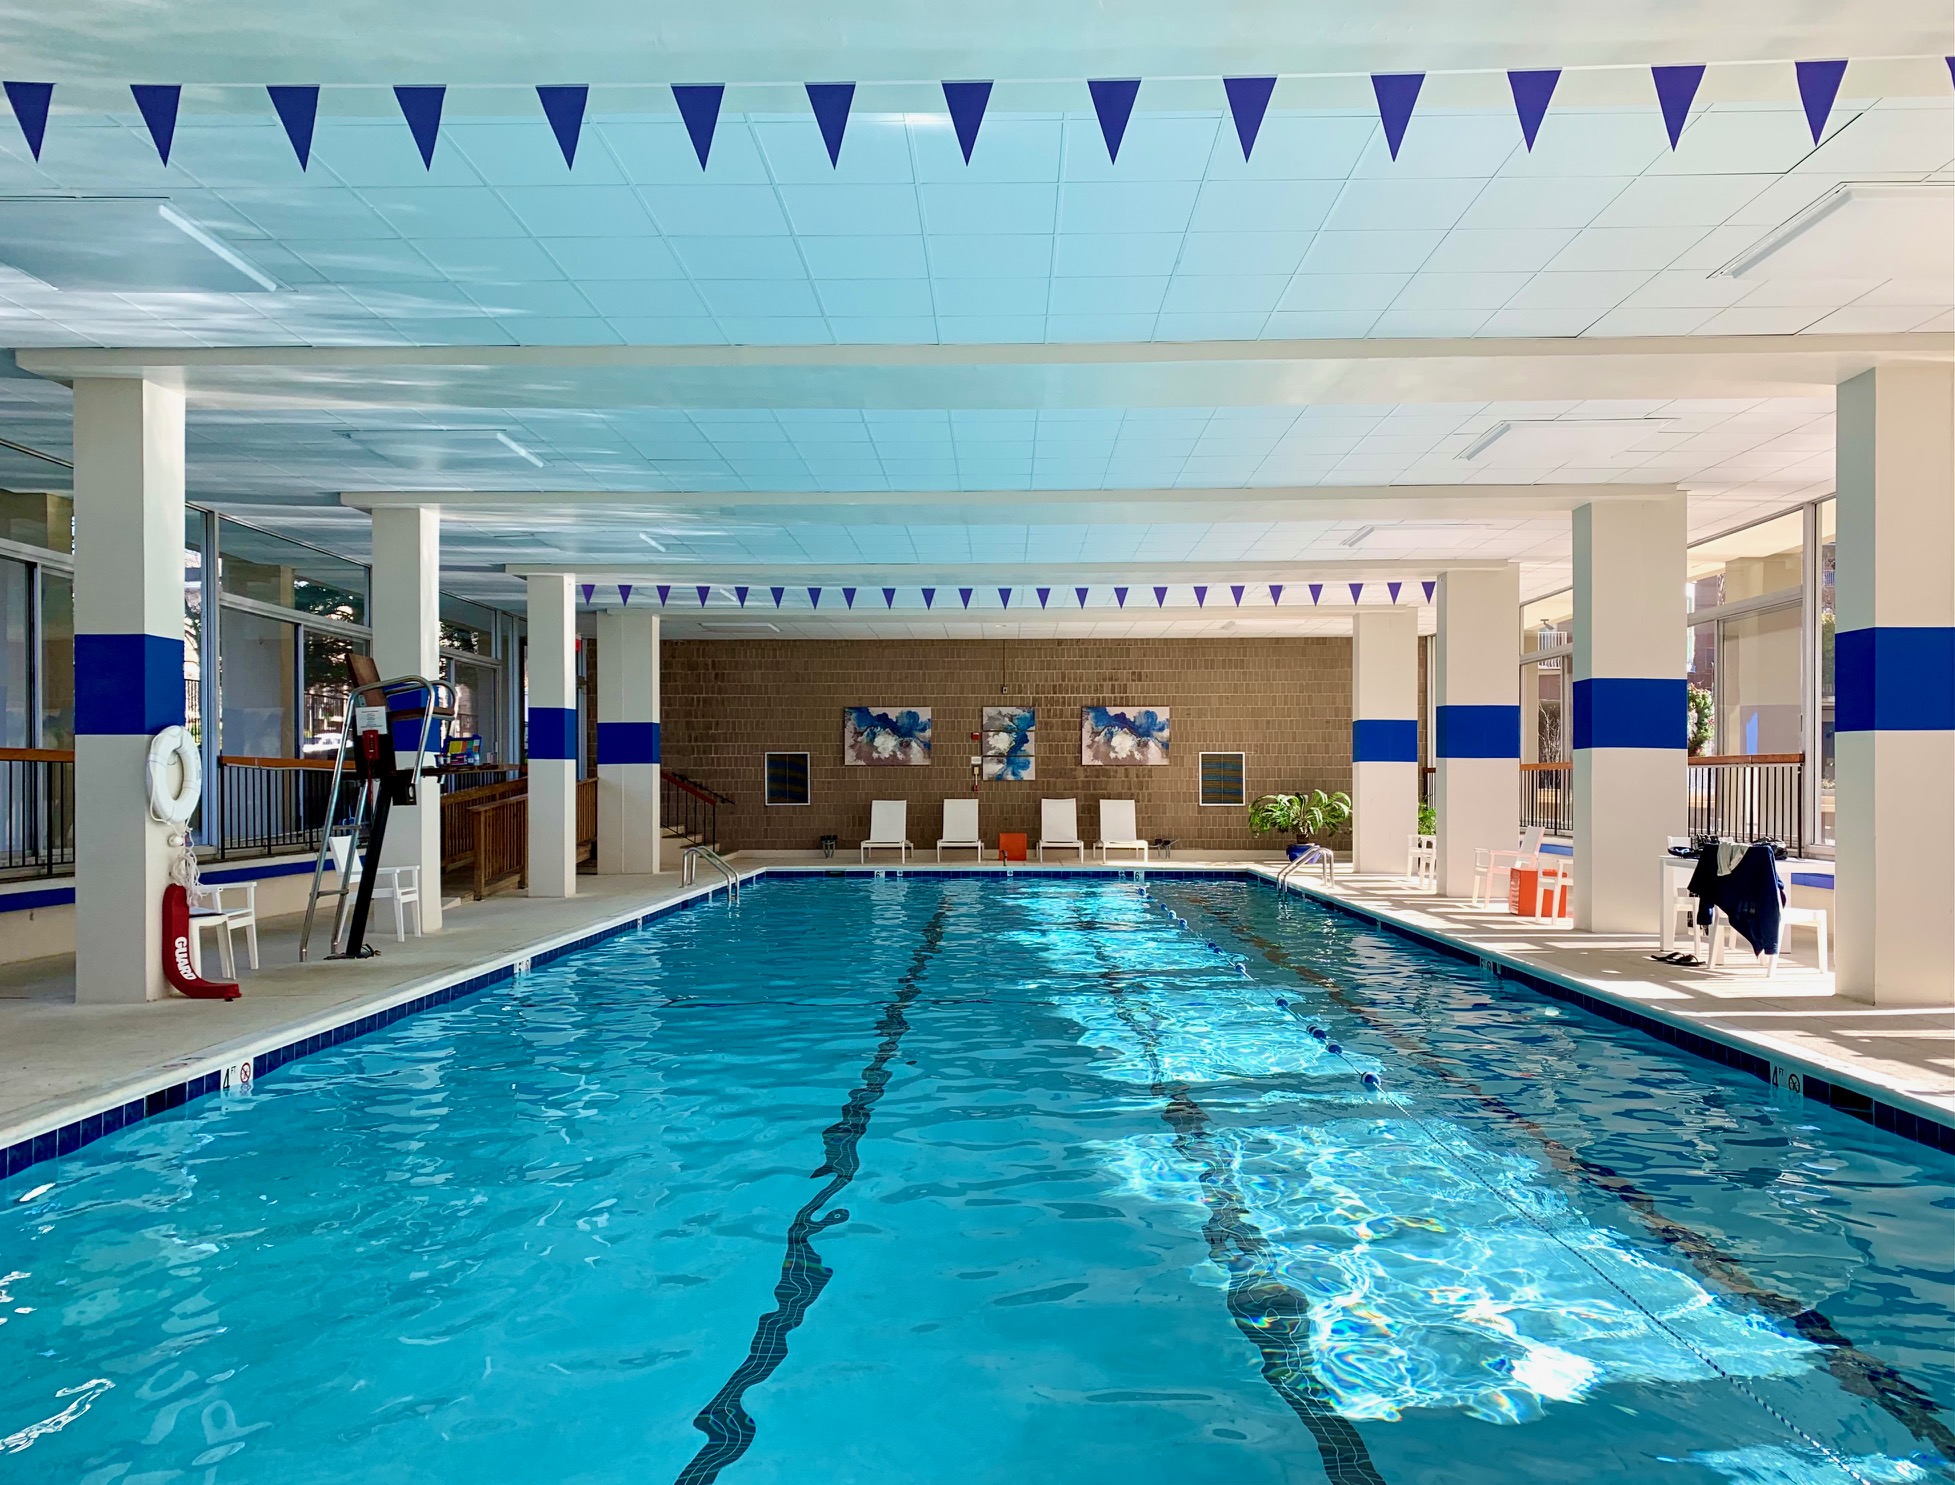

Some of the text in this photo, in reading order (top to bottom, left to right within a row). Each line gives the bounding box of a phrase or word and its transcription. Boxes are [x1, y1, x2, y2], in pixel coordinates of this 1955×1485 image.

[174, 936, 197, 980] GUARD
[222, 1065, 236, 1089] 4 FT
[1772, 1065, 1784, 1087] 4 FT
